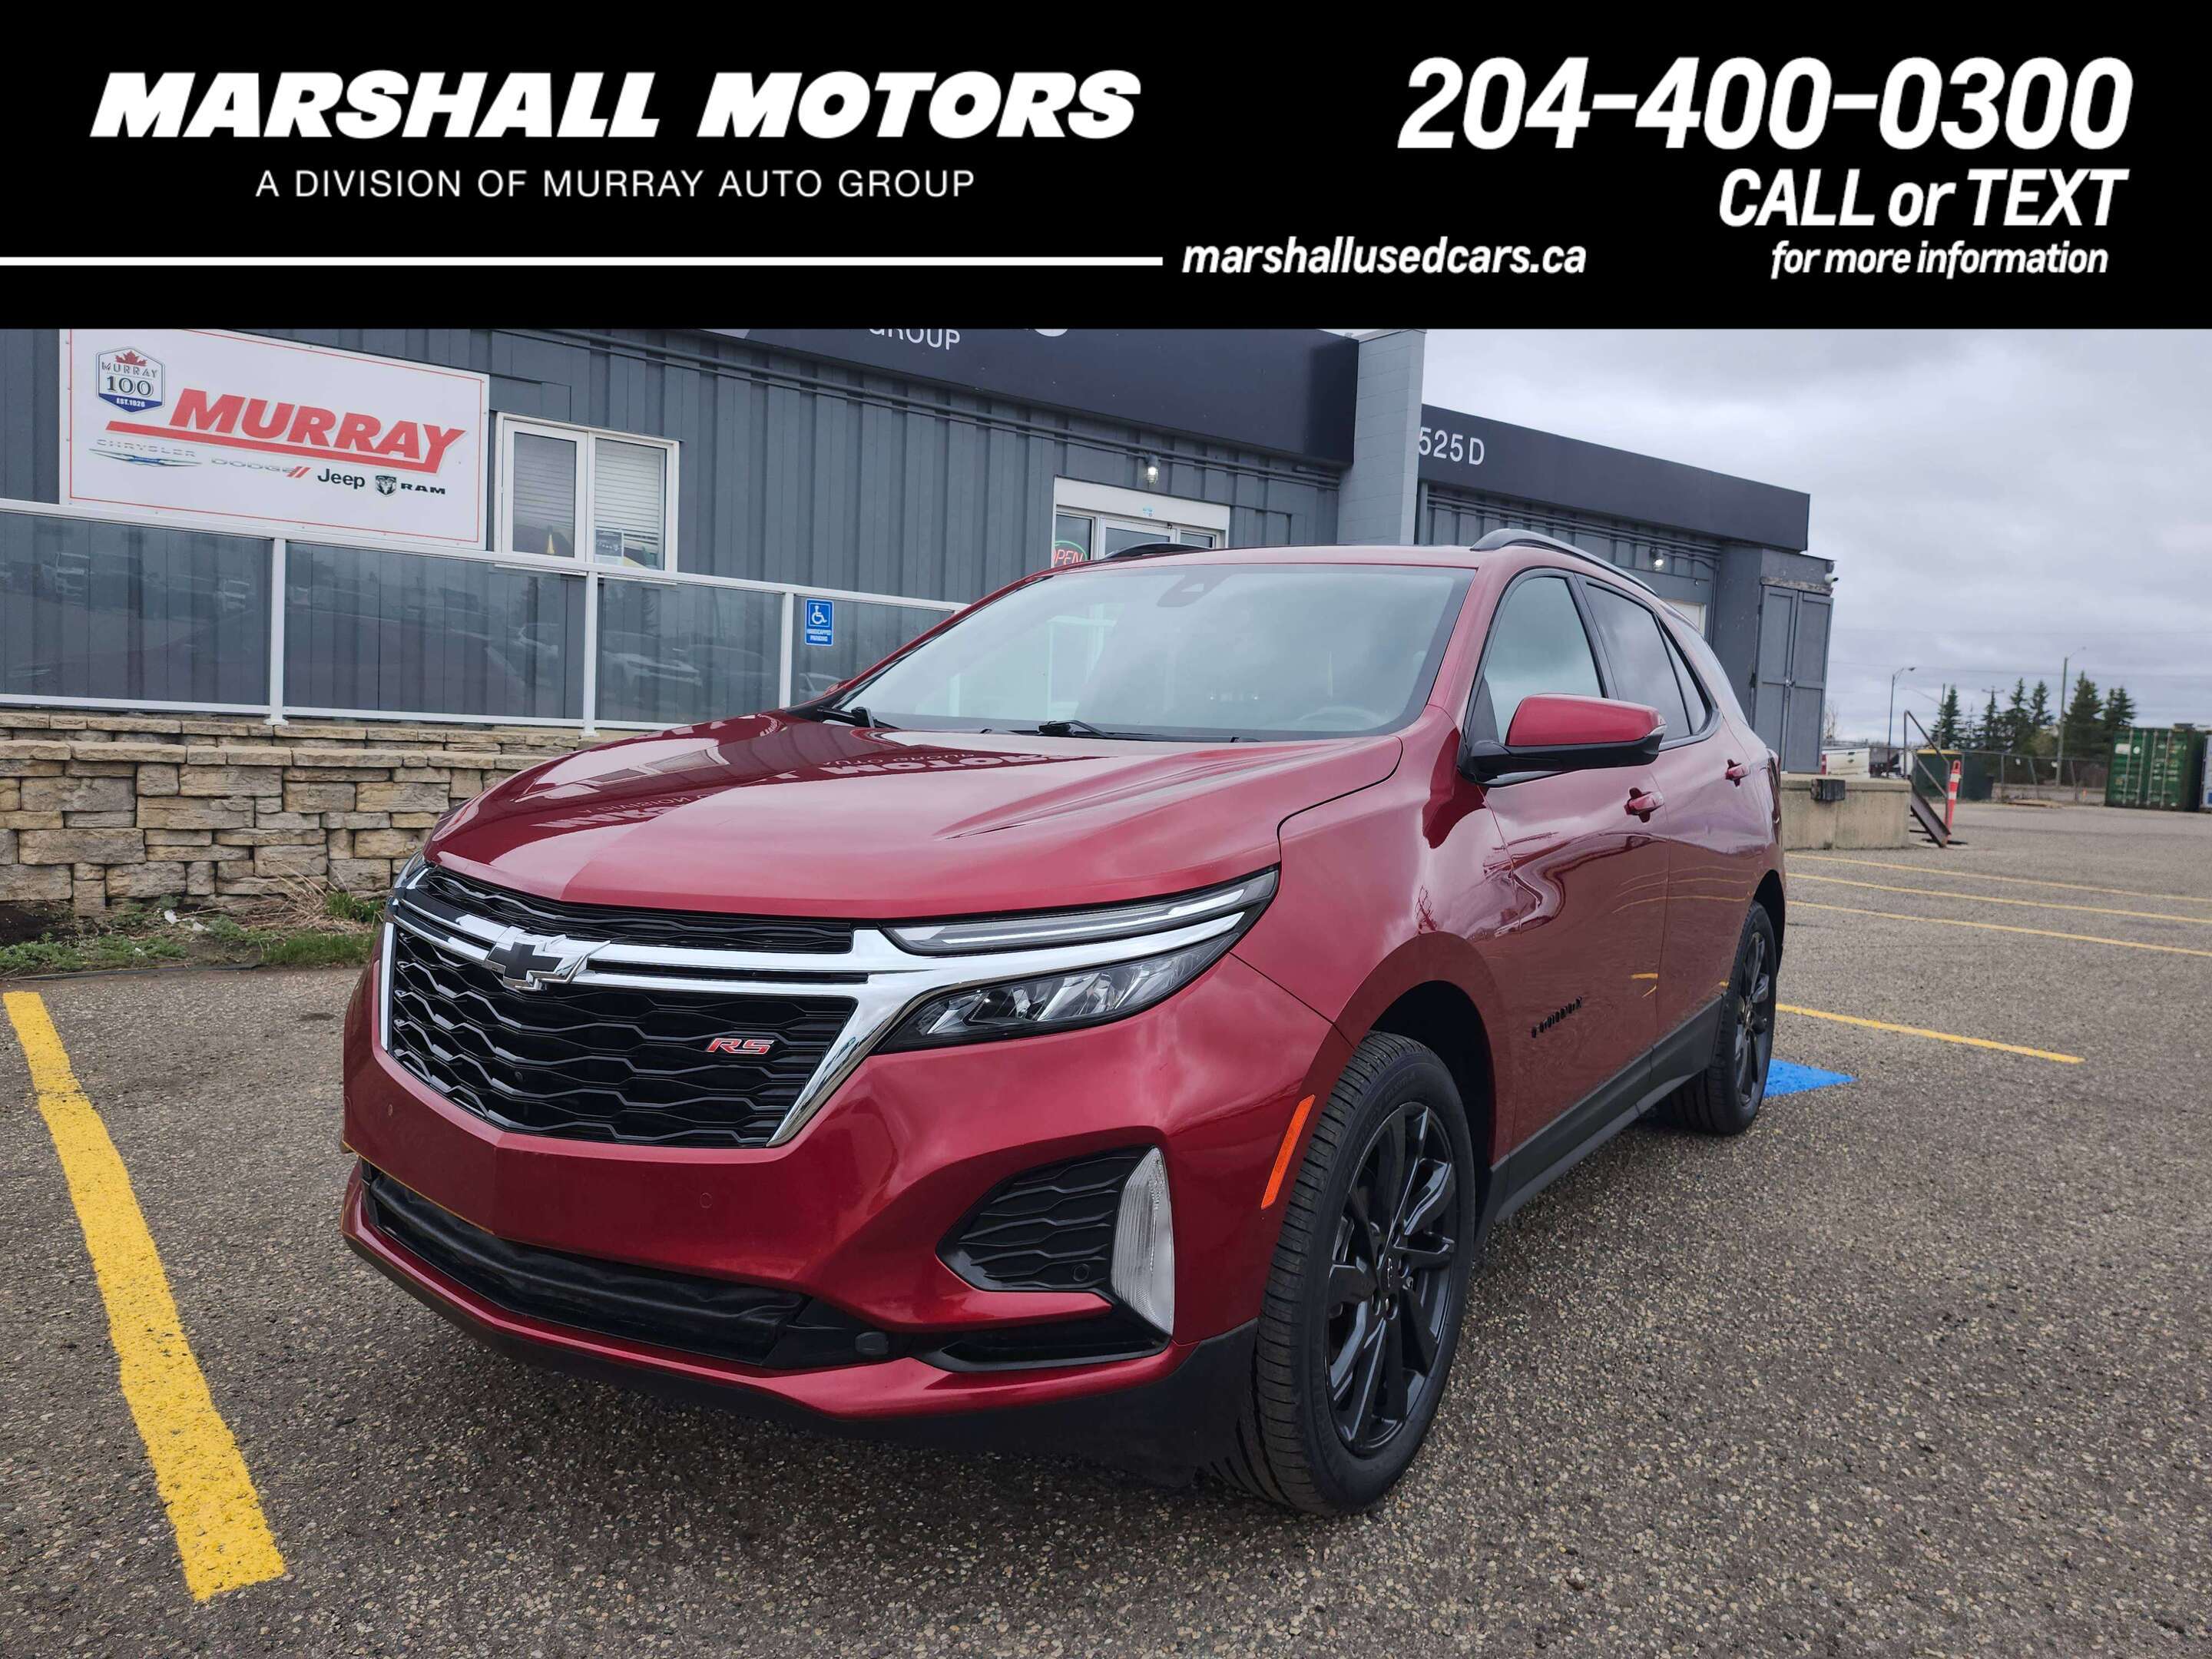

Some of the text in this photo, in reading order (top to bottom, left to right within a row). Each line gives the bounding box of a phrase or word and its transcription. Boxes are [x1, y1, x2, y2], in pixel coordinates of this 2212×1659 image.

[101, 361, 158, 378] MURRAY
[106, 375, 154, 397] 100
[169, 388, 466, 463] MURRAY
[96, 439, 196, 458] CHRYSLER
[317, 468, 366, 489] Jeep
[400, 482, 445, 495] RAM
[707, 1038, 775, 1055] RS
